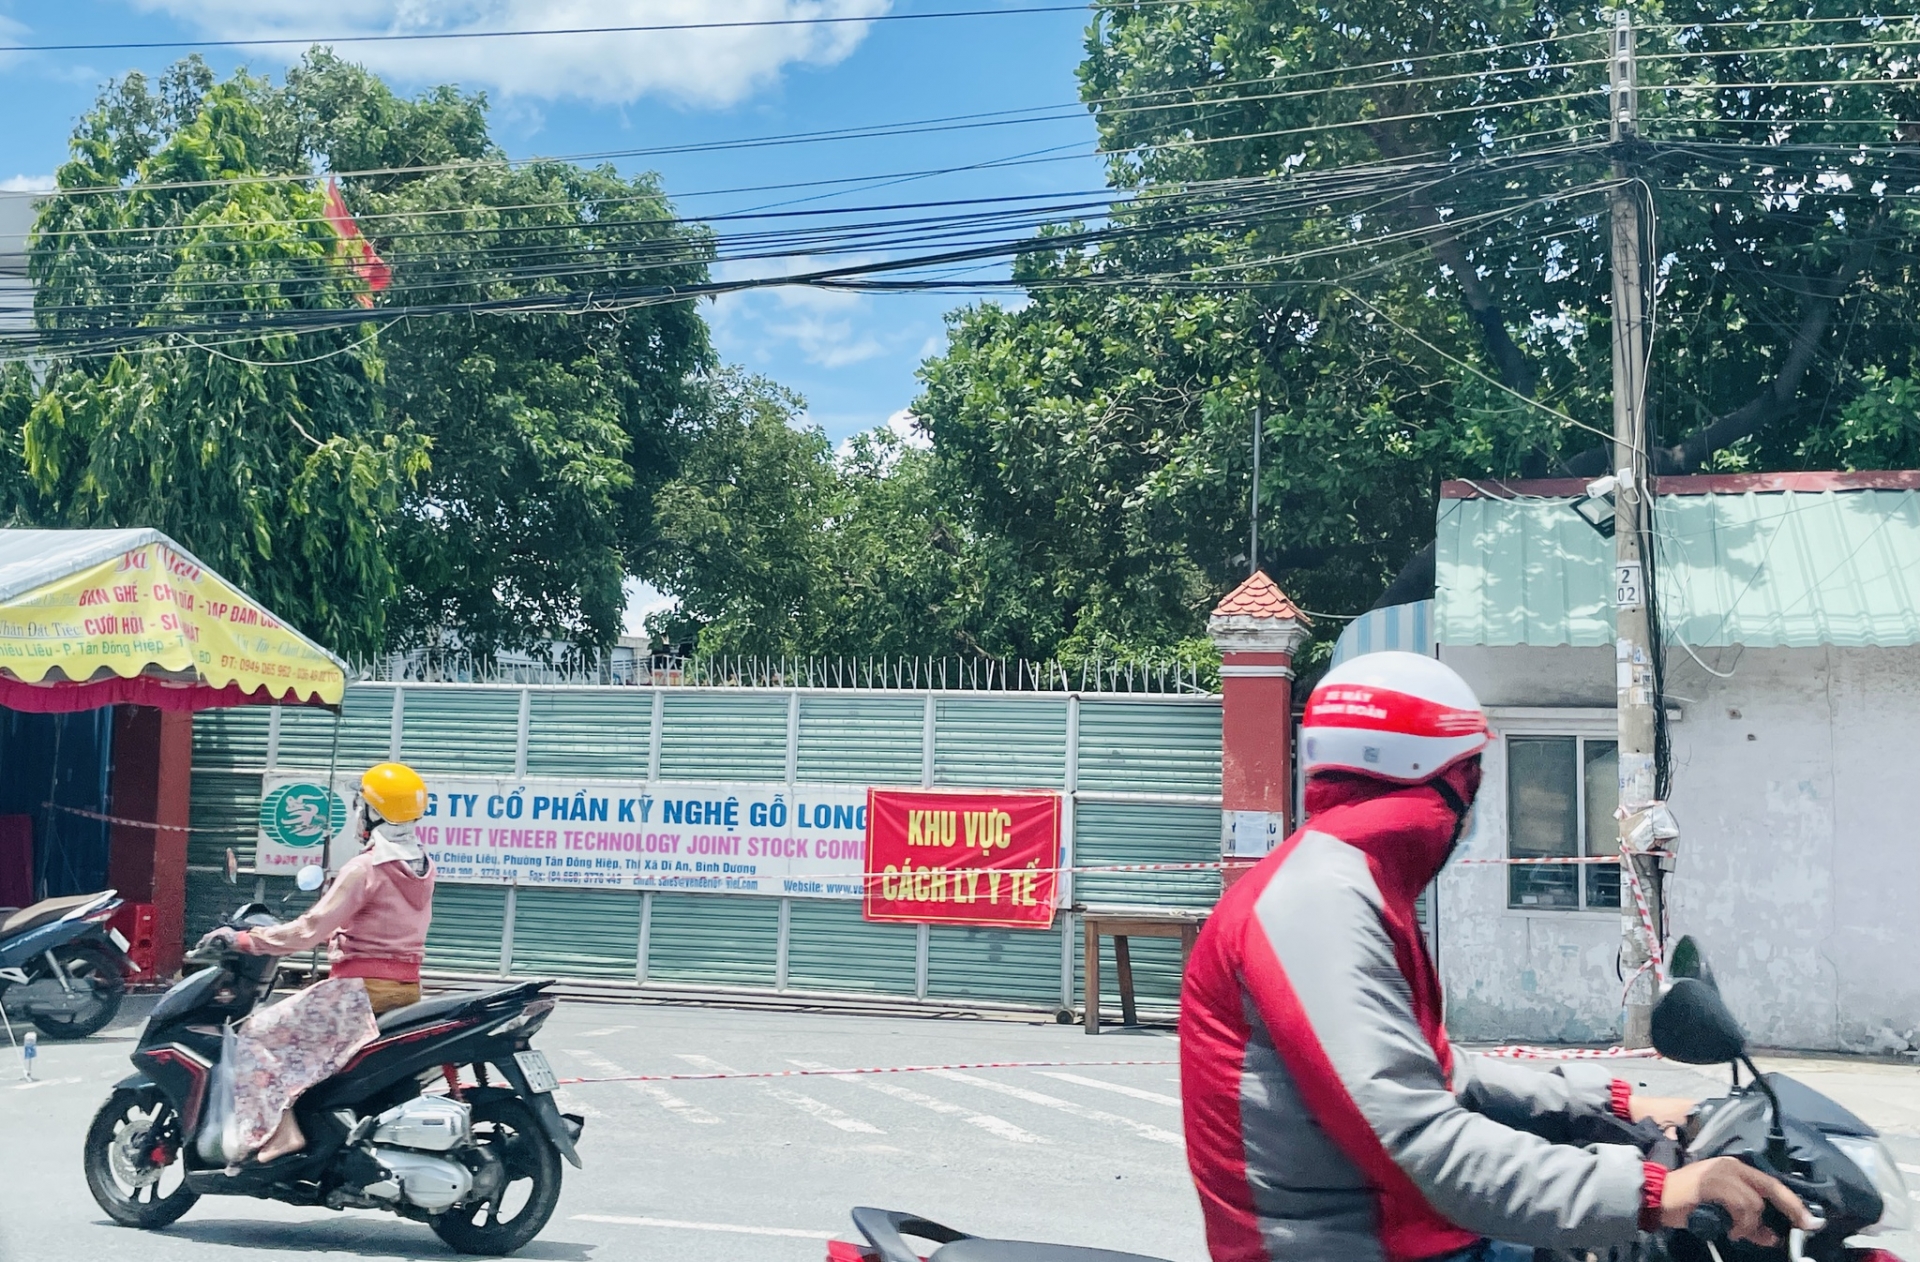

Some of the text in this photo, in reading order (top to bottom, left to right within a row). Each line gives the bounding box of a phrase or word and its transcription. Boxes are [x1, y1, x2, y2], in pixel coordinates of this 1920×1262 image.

[1621, 569, 1631, 584] 2
[1617, 586, 1636, 602] 02
[448, 794, 479, 818] TY
[487, 786, 526, 820] CỔ
[532, 789, 608, 822] PHẦN
[618, 794, 655, 824] KỸ
[663, 797, 740, 831] NGHỆ
[750, 793, 788, 828] GỖ
[798, 803, 868, 831] LONG
[445, 827, 483, 848] VIET
[488, 828, 558, 850] VENEER
[564, 830, 681, 854] TECHNOLOGY
[686, 834, 742, 857] JOINT
[746, 837, 809, 859] STOCK
[908, 808, 1012, 857] KHU VỰC
[783, 879, 824, 894] Website:
[882, 857, 1041, 907] CÁCH LY Y TẾ
